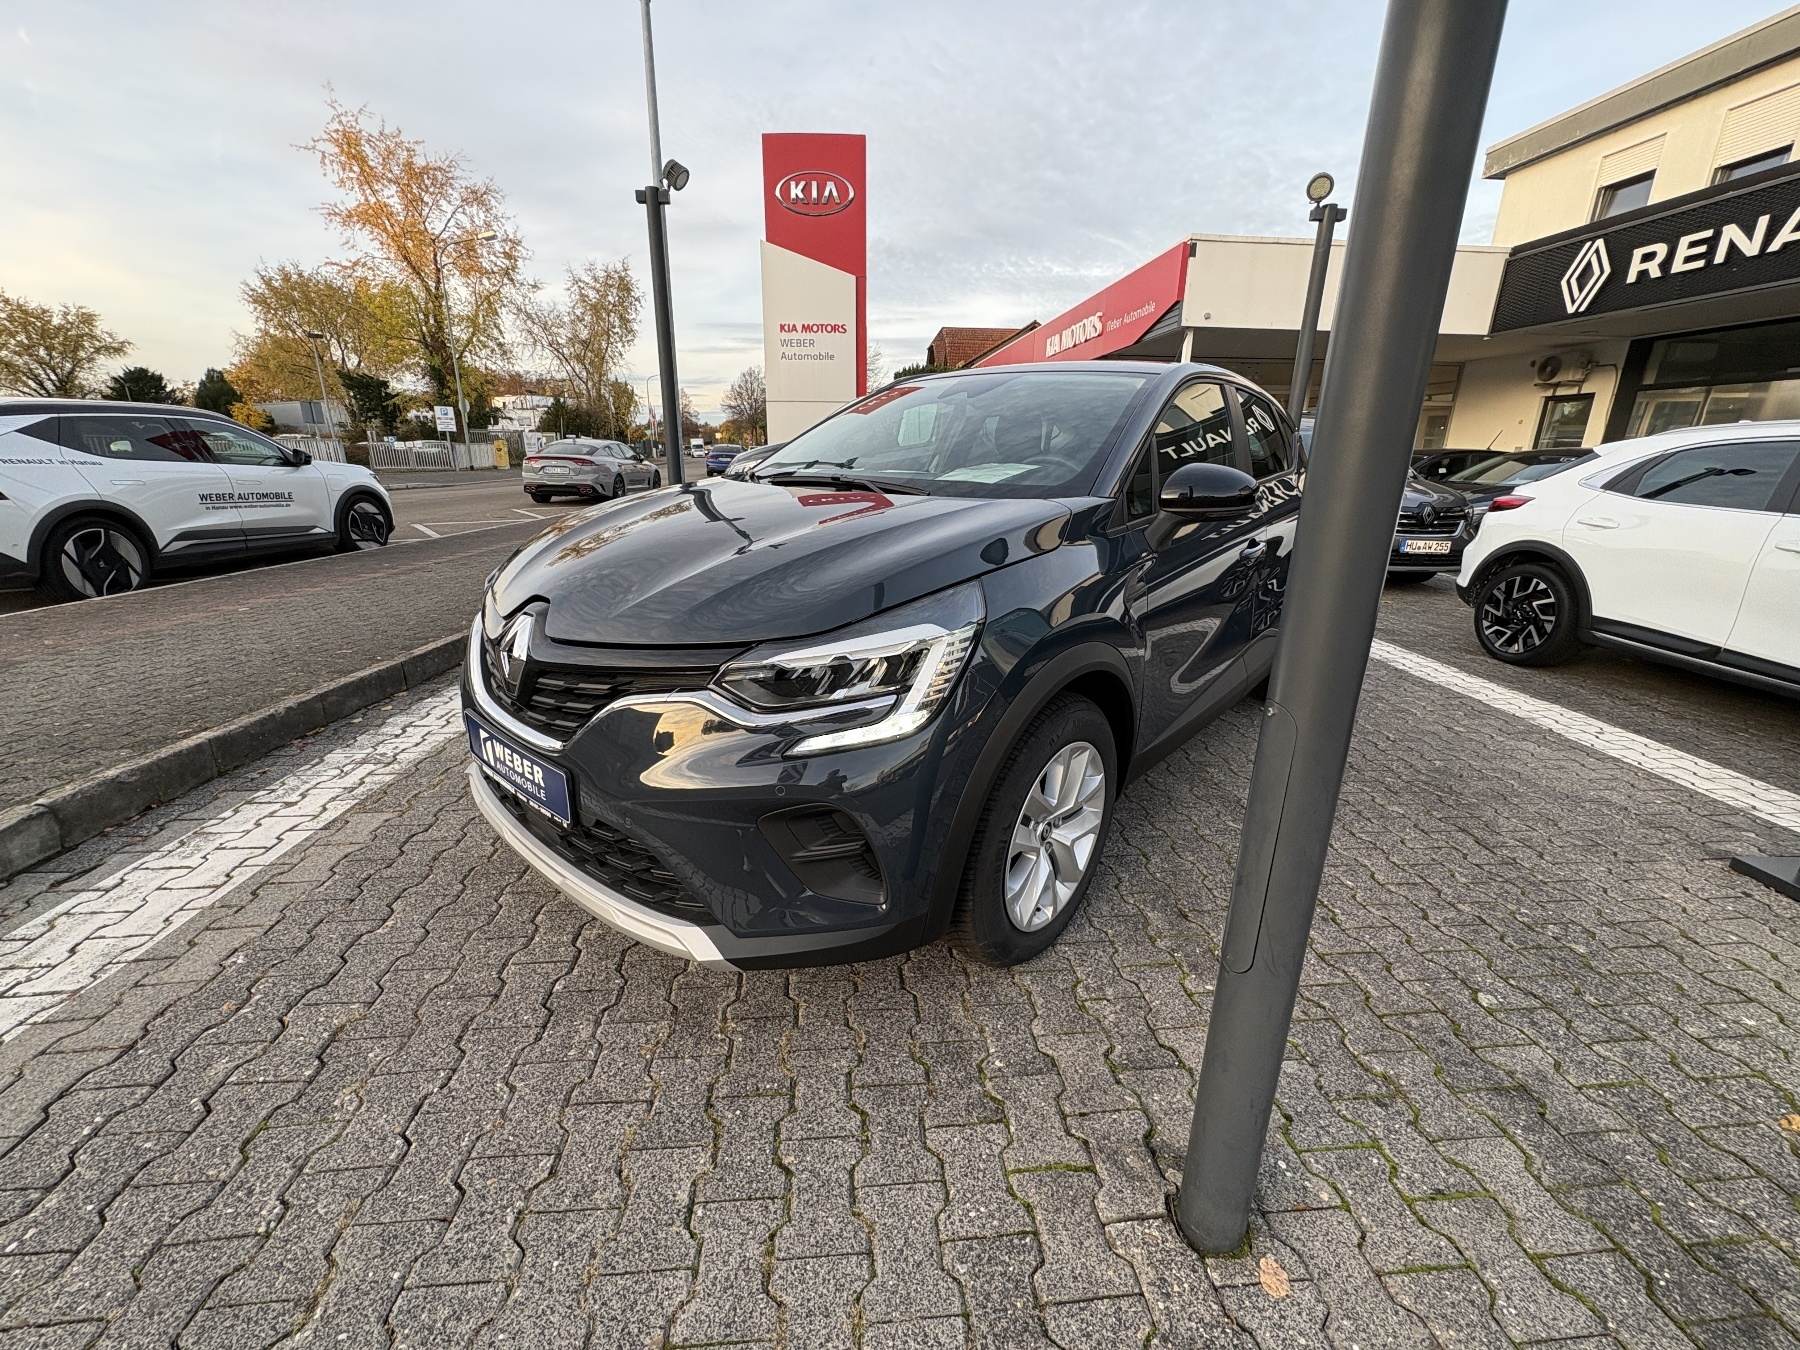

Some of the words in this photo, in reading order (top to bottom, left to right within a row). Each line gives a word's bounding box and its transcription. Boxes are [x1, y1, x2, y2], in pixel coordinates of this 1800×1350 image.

[789, 180, 841, 204] KIA
[779, 323, 798, 334] KIA
[801, 323, 847, 334] MOTORS
[1045, 334, 1060, 358] KIA
[1060, 311, 1103, 351] MOTORS
[1123, 301, 1156, 325] Automobile
[780, 338, 815, 348] WEBER
[780, 351, 835, 361] Automobile
[198, 493, 234, 502] WEBER
[236, 491, 294, 501] AUTOMOBILE
[1434, 542, 1450, 551] 255
[492, 738, 545, 787] WEBER
[495, 762, 547, 801] AUTOMOBILE
